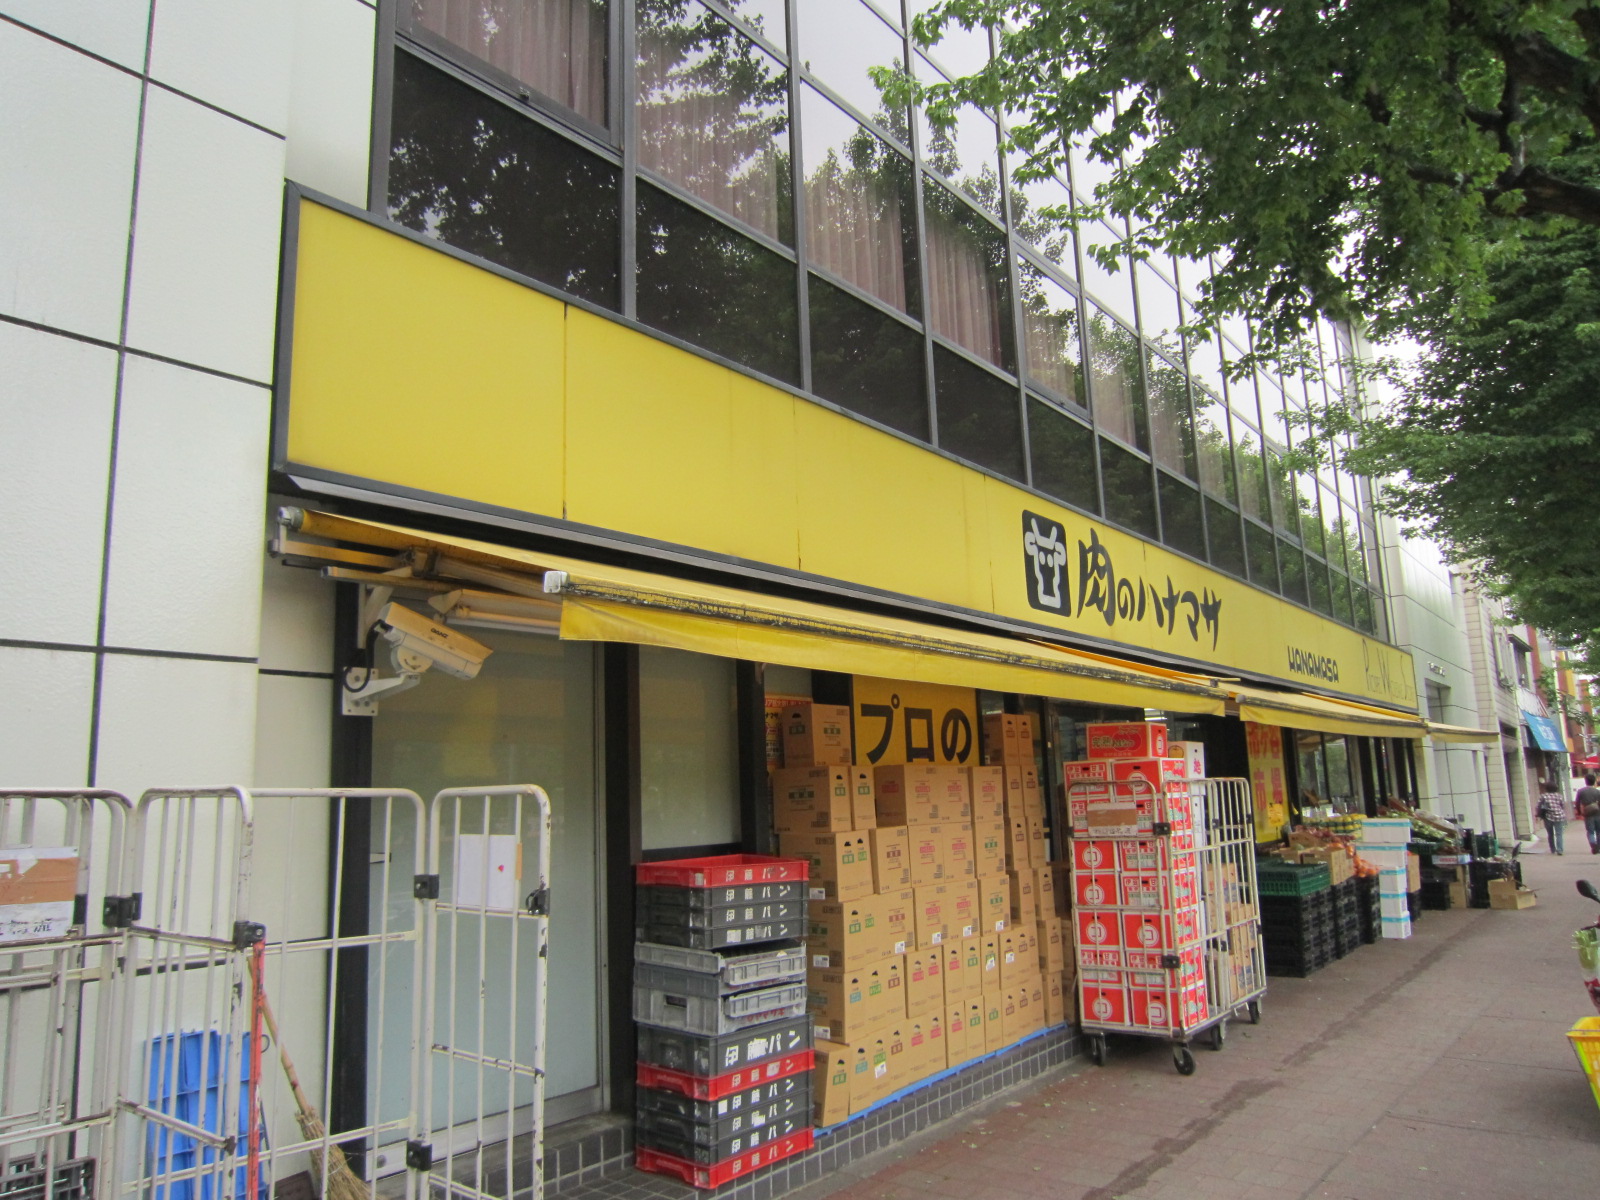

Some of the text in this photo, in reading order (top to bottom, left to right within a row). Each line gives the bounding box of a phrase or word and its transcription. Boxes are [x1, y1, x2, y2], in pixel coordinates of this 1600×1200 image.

[1077, 527, 1222, 652] 肉のハナマサ
[1287, 645, 1339, 683] HANAMASA
[860, 694, 972, 765] プロの
